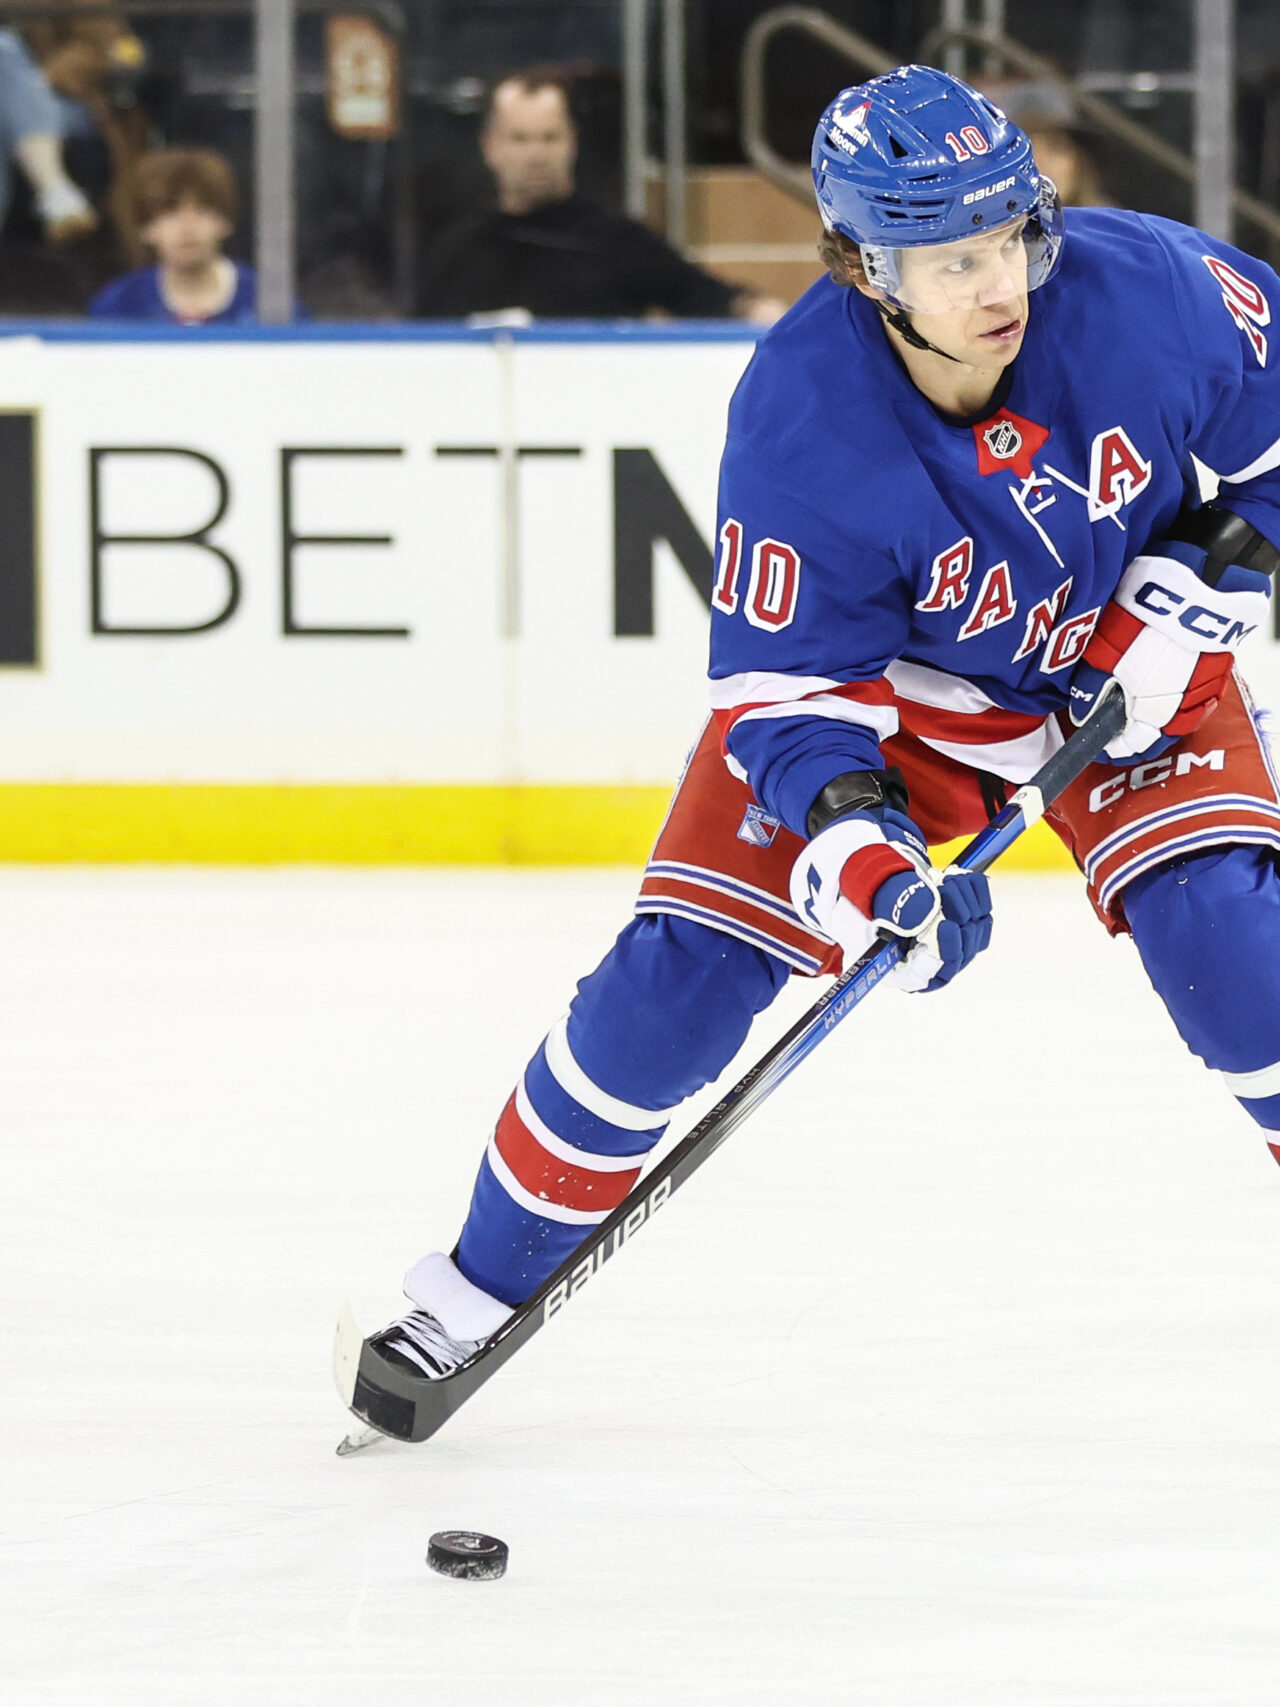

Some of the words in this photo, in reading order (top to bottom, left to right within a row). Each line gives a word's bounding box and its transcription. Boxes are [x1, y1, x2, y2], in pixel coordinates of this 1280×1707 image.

[945, 125, 989, 163] 10
[963, 176, 1016, 206] BAUER
[1201, 254, 1272, 369] 10
[1086, 425, 1152, 523] A
[711, 517, 801, 633] 10
[914, 536, 1101, 675] RANG
[1134, 581, 1258, 646] CCM
[1070, 685, 1094, 702] CM
[1088, 749, 1226, 813] CCM
[892, 880, 926, 925] CCM
[817, 965, 860, 1007] BAUER
[823, 943, 900, 1030] HYPERLIT
[686, 1067, 761, 1140] HYPRLITE
[543, 1175, 672, 1324] BAUER
